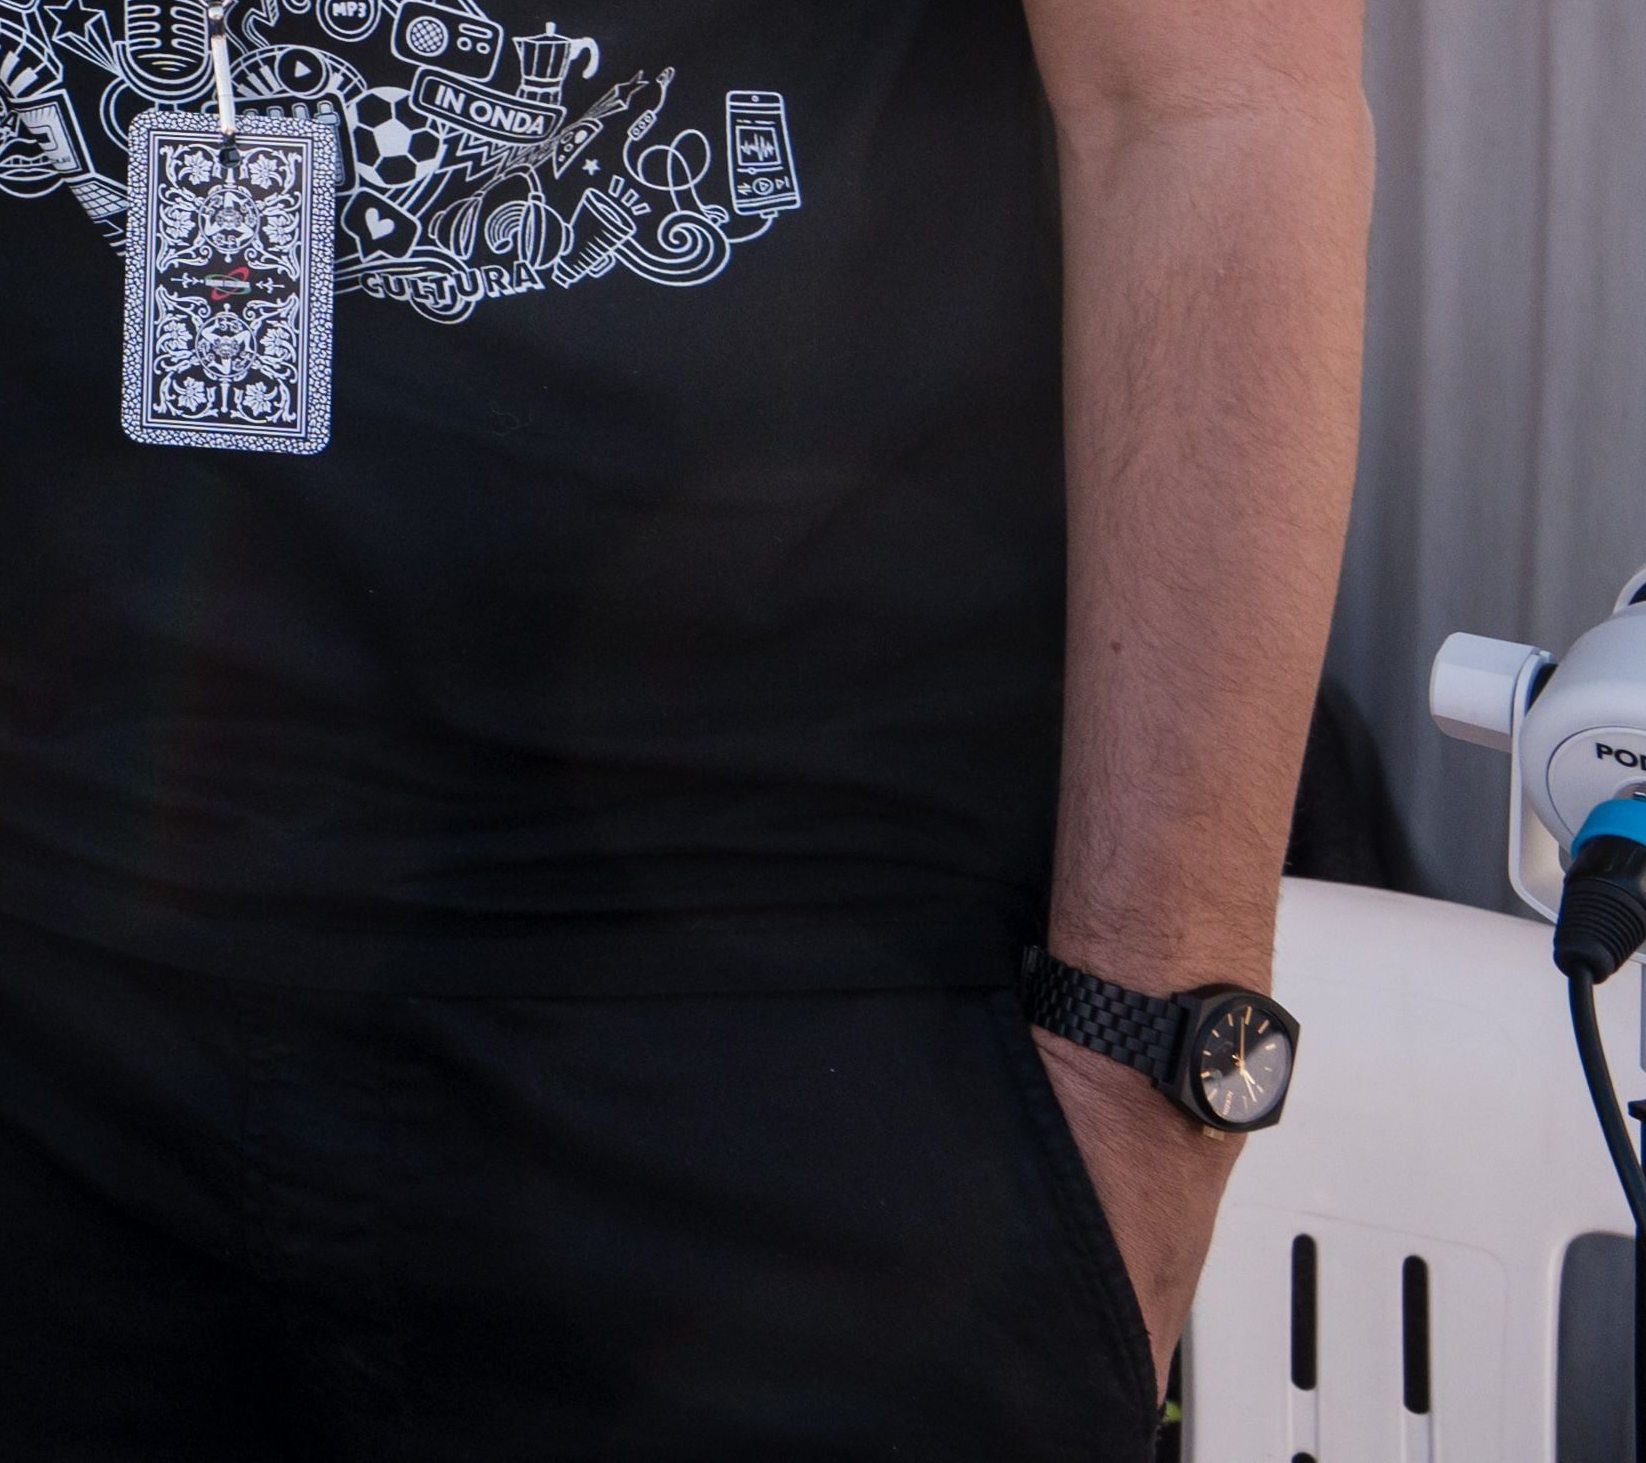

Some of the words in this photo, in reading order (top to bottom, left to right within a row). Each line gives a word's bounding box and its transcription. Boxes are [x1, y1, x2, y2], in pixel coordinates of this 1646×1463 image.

[332, 1, 367, 18] MP3
[435, 85, 466, 114] IN
[469, 101, 546, 136] ONDA
[359, 261, 547, 307] CULTURA
